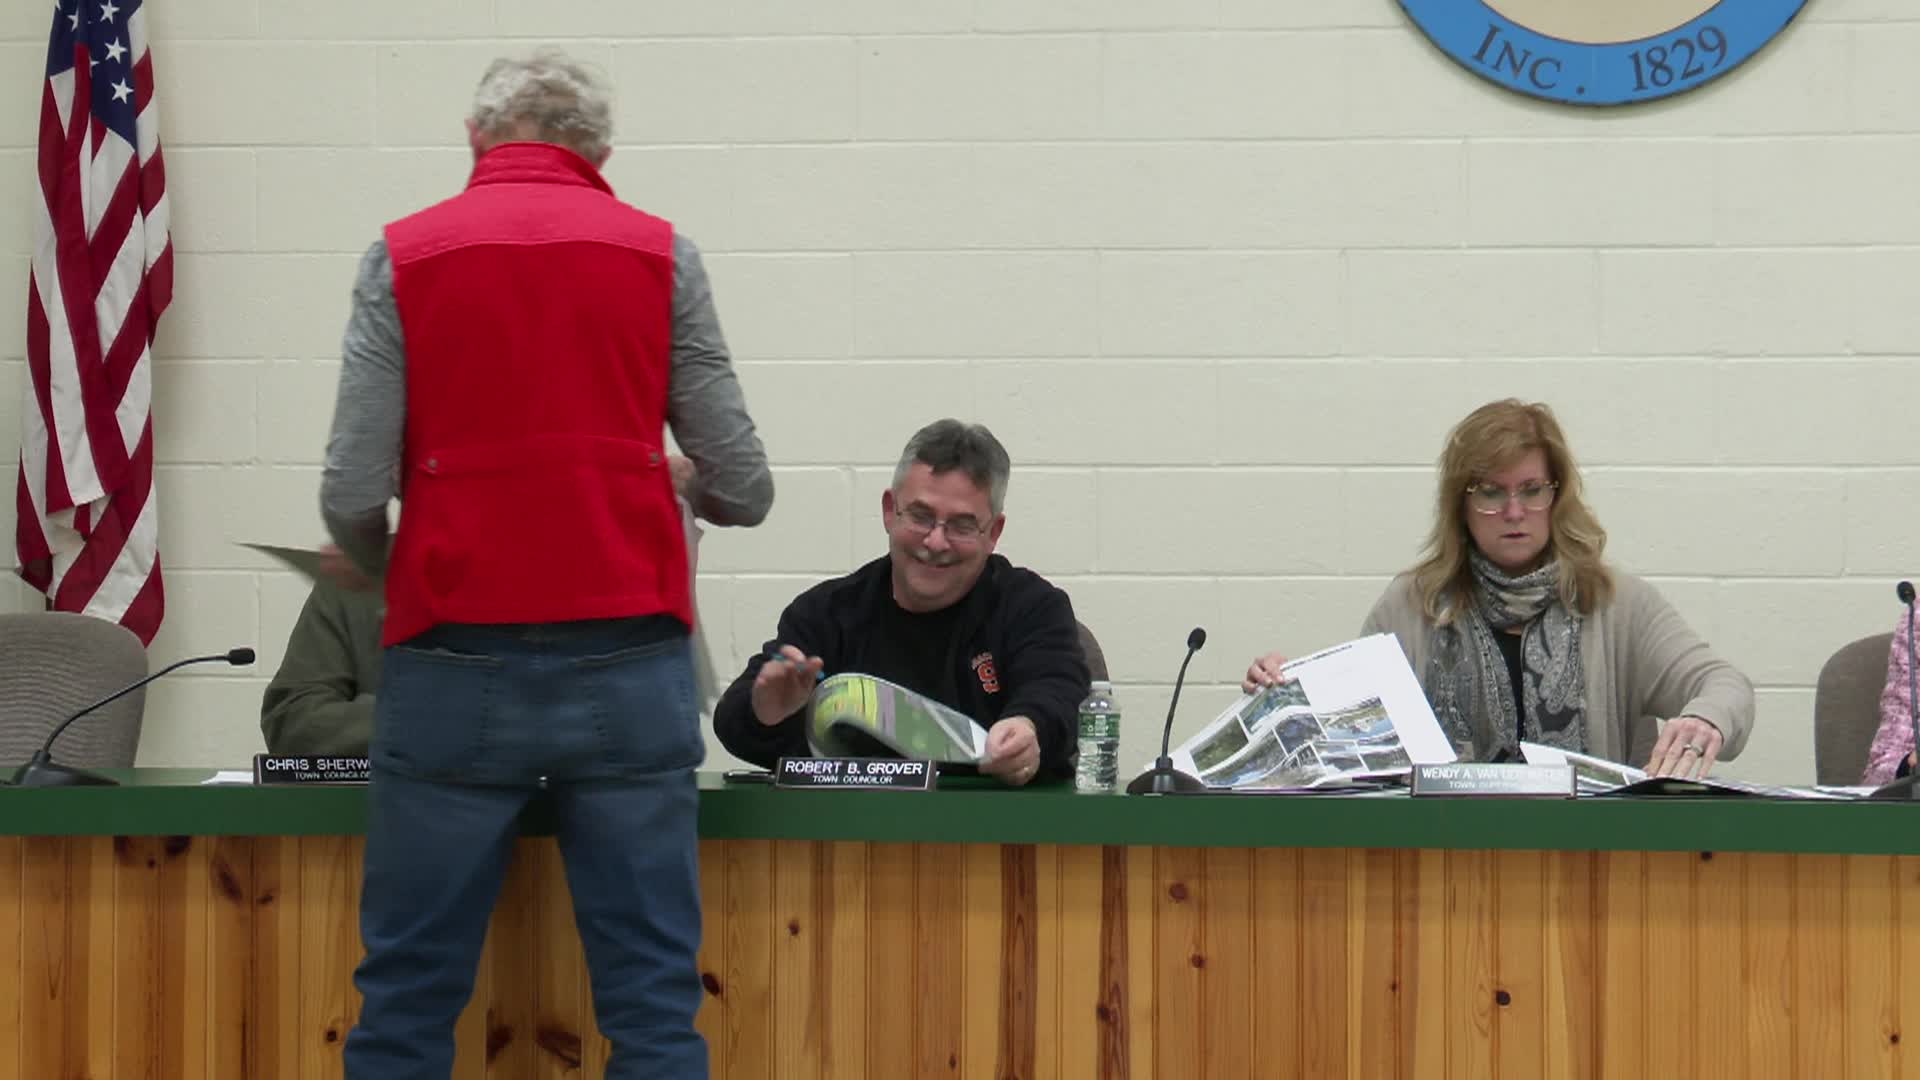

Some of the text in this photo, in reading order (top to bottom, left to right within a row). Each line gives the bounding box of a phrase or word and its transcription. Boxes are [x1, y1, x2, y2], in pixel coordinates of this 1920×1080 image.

[1628, 25, 1727, 92] 1829
[265, 758, 310, 771] CHRIS
[784, 760, 923, 775] ROBERT B. GROVER
[295, 771, 320, 780] TOWN
[1422, 767, 1459, 779] WENDY
[812, 775, 893, 784] TOWN COUNCILOR
[1449, 781, 1475, 789] TOWN
